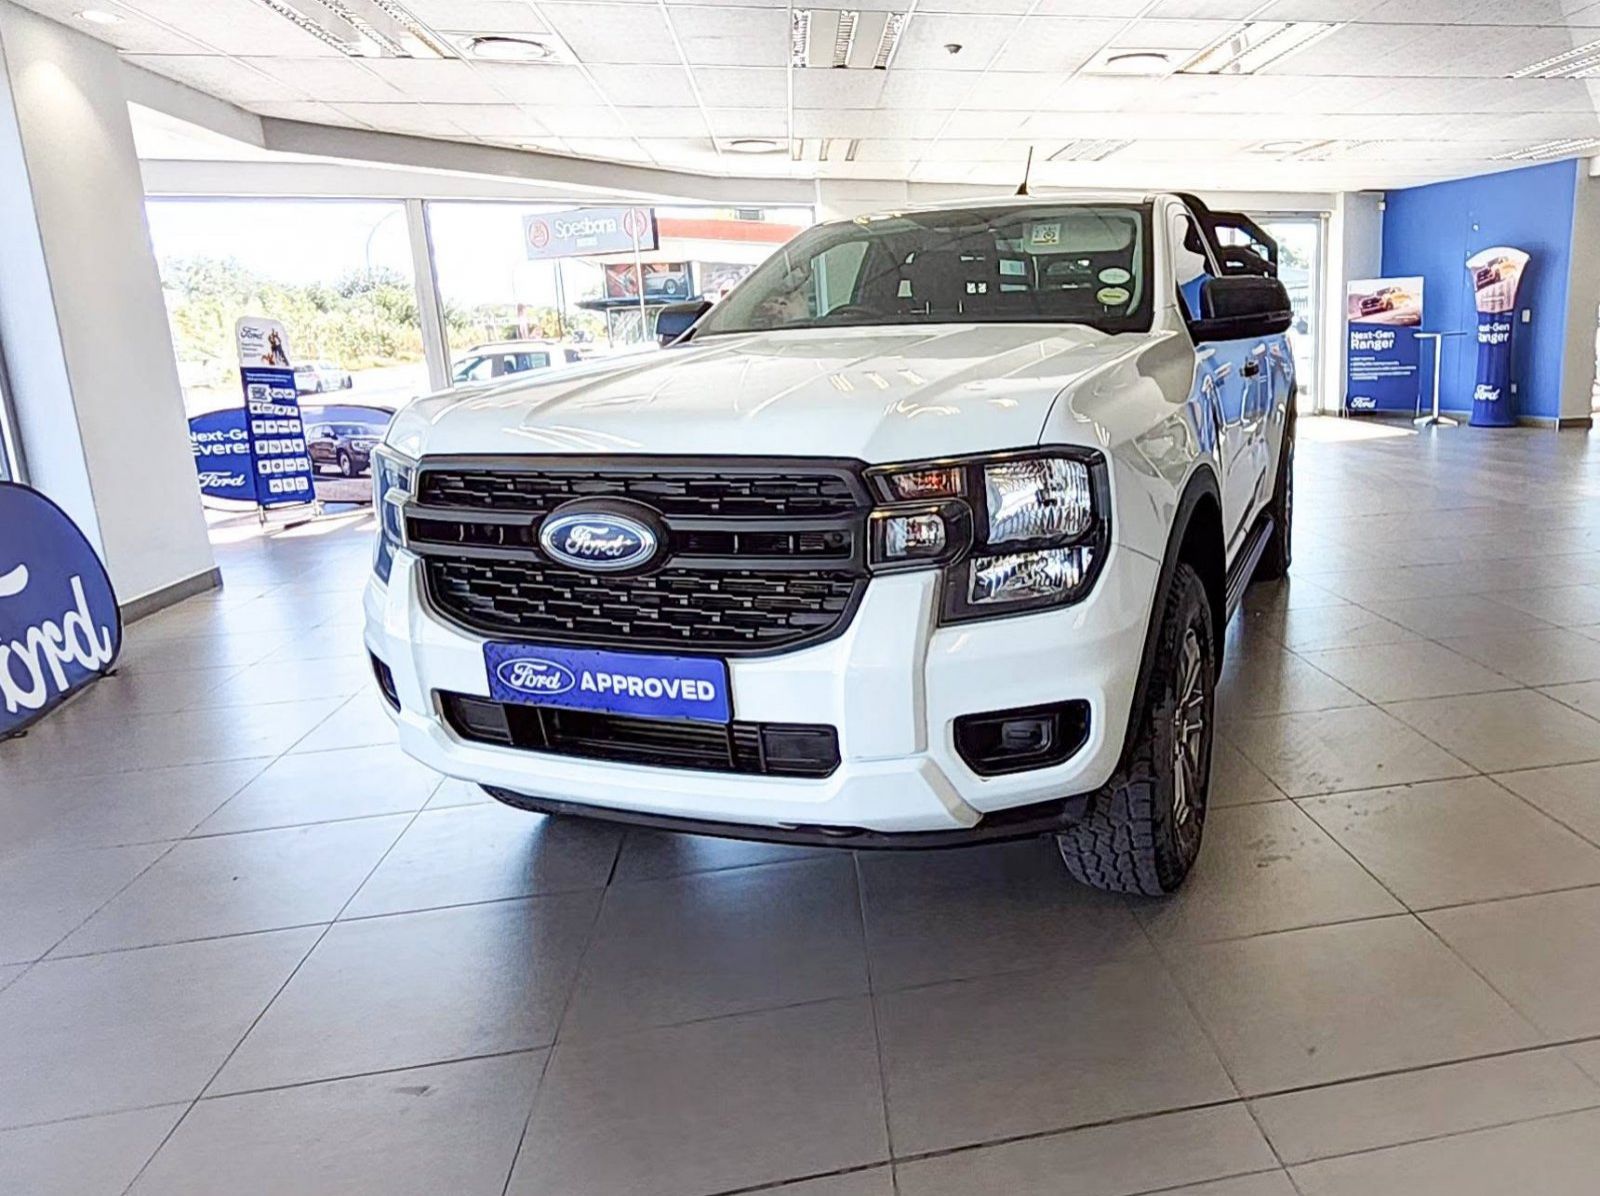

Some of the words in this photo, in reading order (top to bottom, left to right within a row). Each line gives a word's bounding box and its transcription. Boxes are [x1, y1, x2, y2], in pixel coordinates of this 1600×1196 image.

[555, 217, 617, 240] Spesbona
[1350, 330, 1395, 340] Next-Gen
[1478, 332, 1509, 344] anger
[1350, 340, 1395, 351] Ranger
[1474, 384, 1500, 401] Ford
[1350, 396, 1376, 408] Ford
[198, 471, 245, 488] Ford
[564, 525, 638, 556] Ford
[510, 661, 561, 690] Ford
[580, 671, 715, 701] APPROVED
